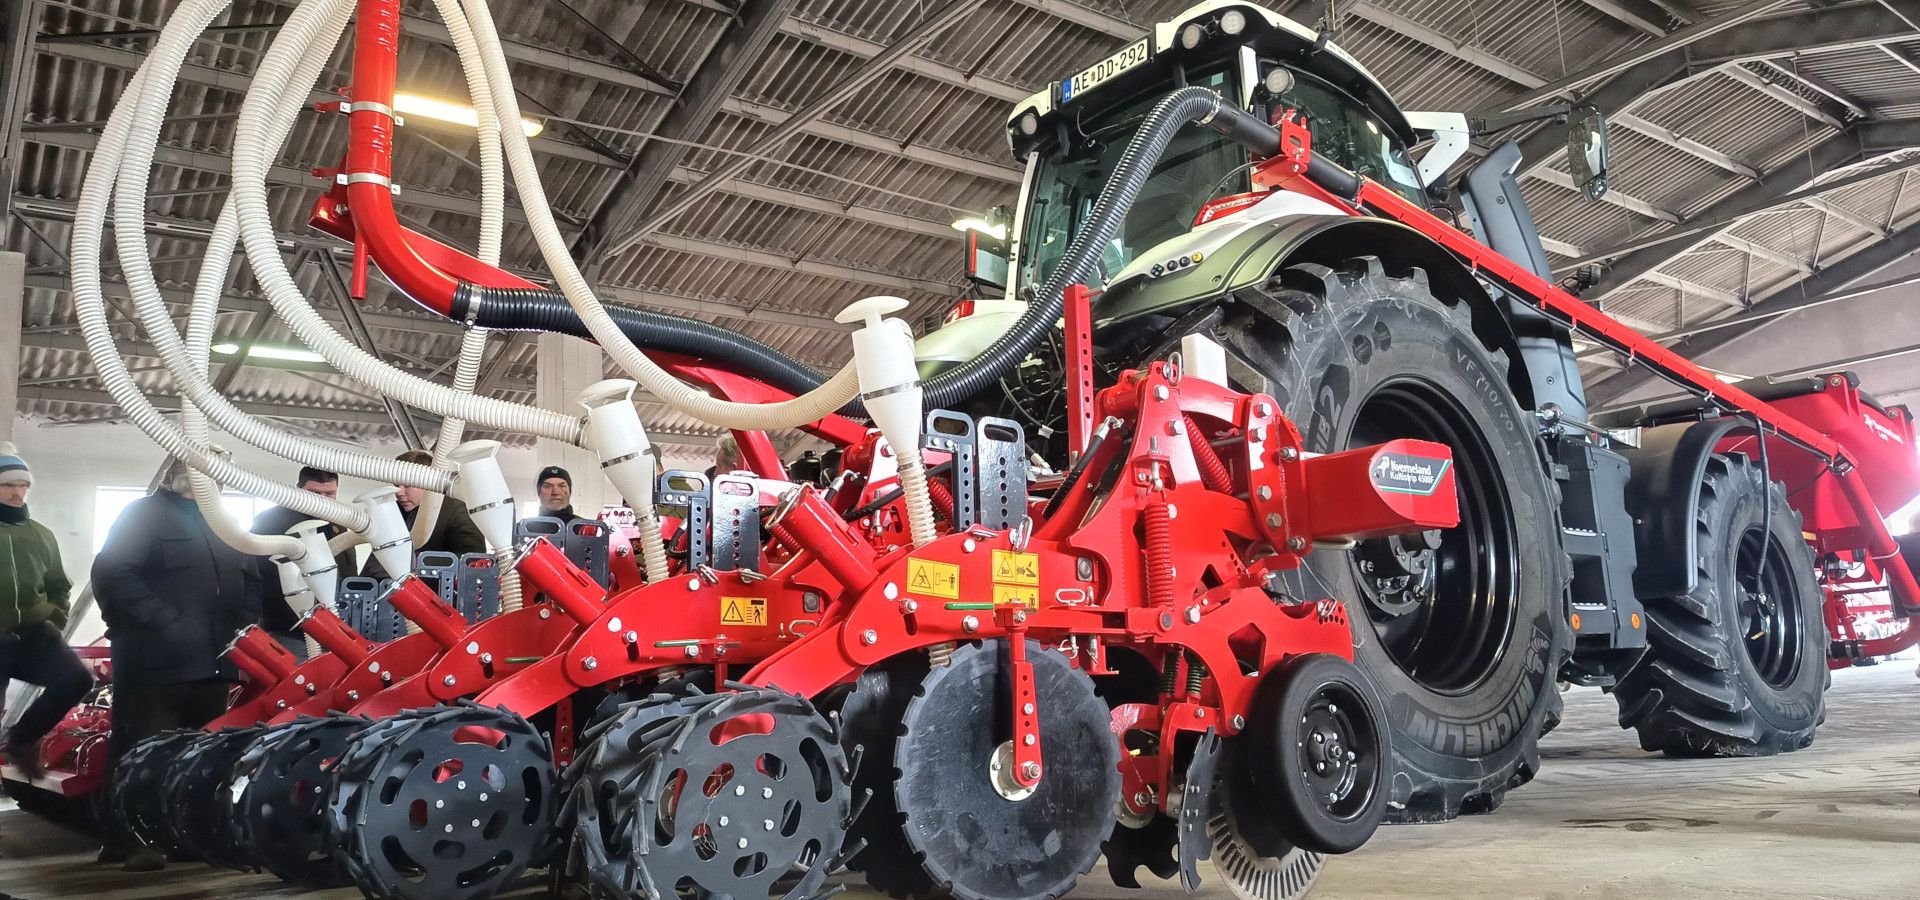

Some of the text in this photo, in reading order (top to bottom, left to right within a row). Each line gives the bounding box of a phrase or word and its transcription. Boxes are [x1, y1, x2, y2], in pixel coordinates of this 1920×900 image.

[1073, 71, 1089, 94] AE
[1320, 385, 1341, 430] 2
[1390, 459, 1432, 476] Kverneland
[1406, 674, 1536, 757] MICHELIN
